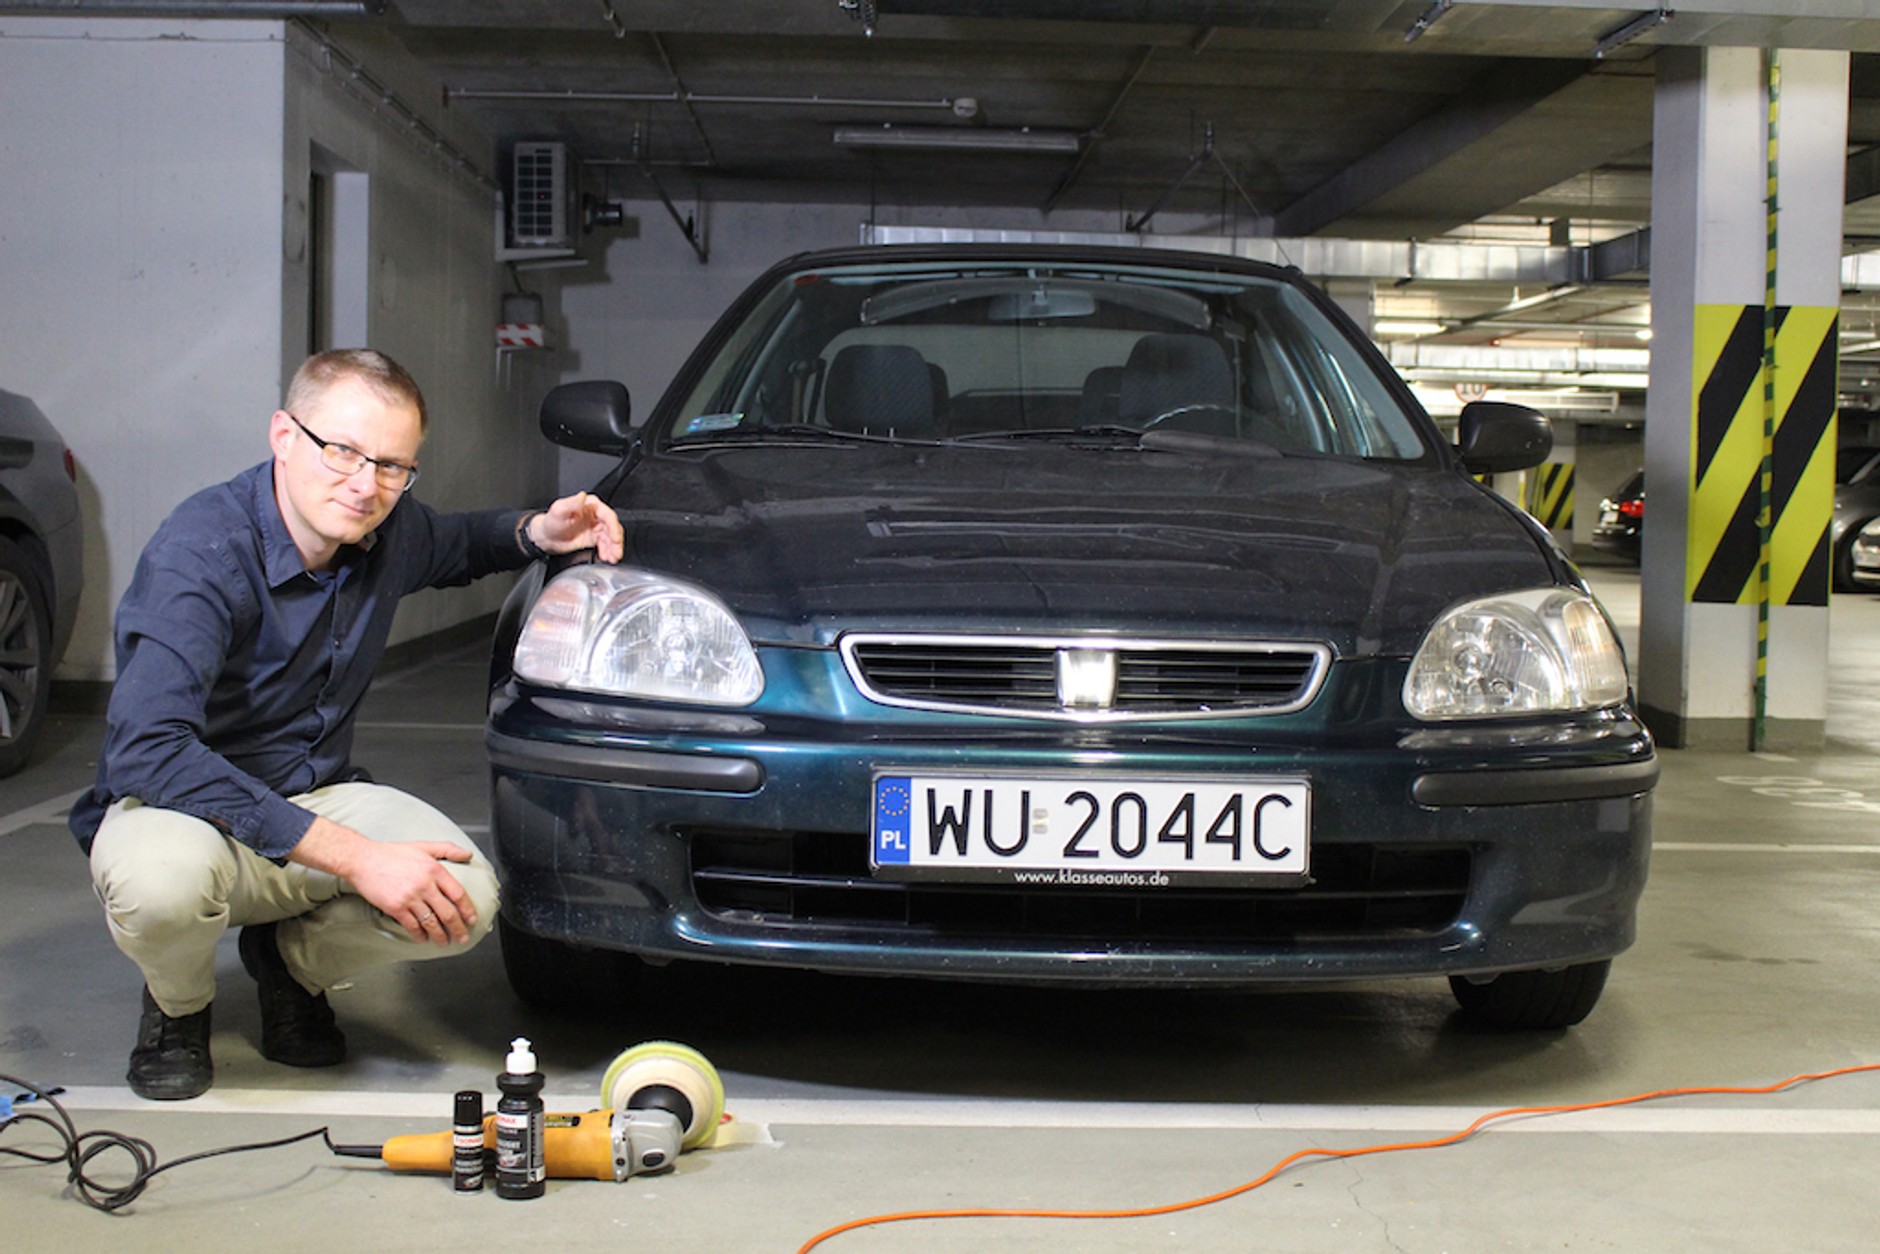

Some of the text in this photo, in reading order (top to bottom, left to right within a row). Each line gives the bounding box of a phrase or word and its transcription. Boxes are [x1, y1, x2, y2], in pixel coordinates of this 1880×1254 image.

[926, 788, 1293, 860] WU 2044C
[880, 830, 906, 850] PL
[1014, 868, 1169, 887] www.klasseautos.de
